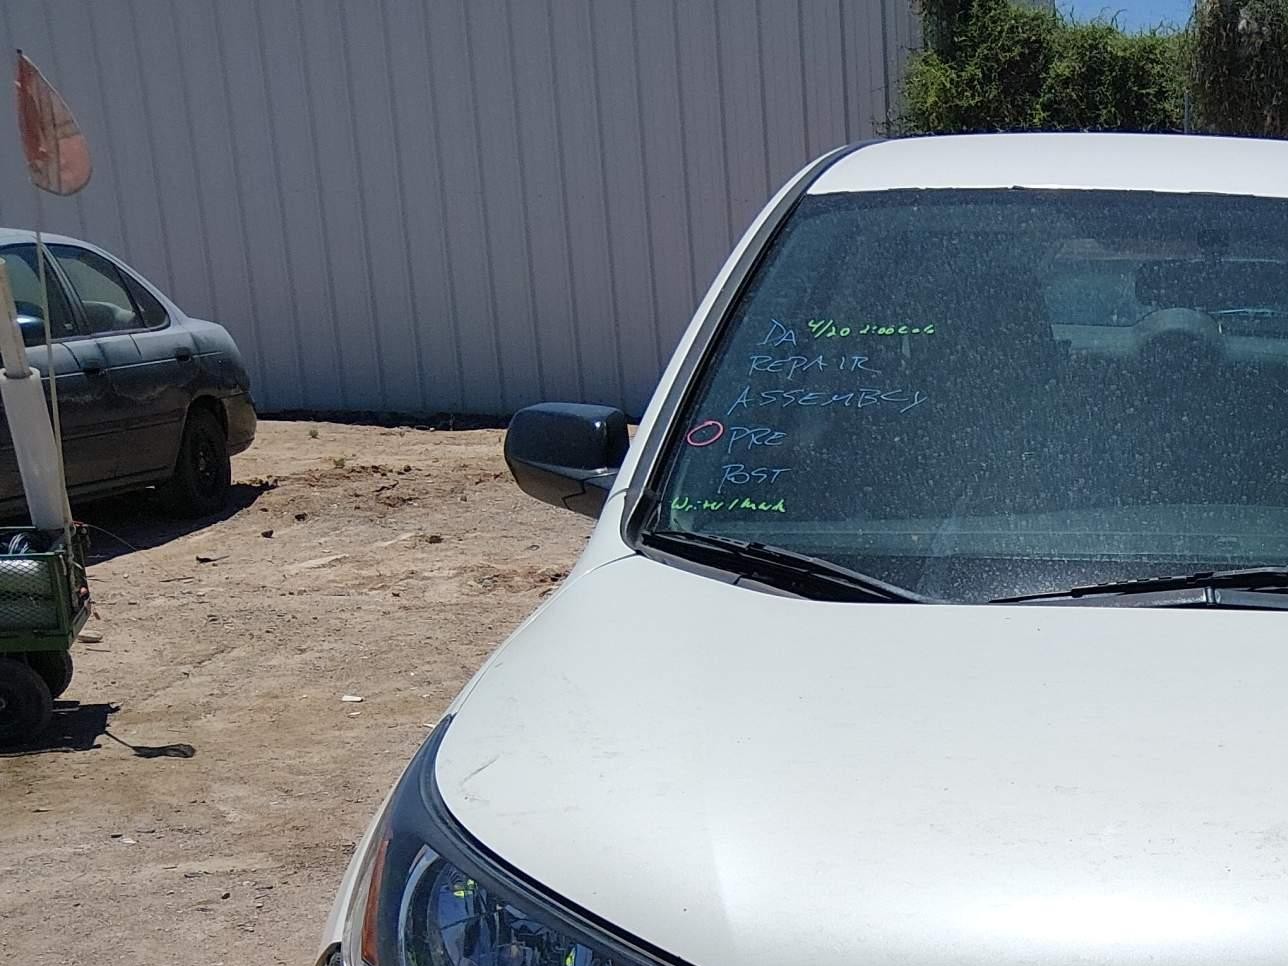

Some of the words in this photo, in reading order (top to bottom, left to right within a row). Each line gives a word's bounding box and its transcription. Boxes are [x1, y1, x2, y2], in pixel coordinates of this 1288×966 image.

[756, 319, 796, 346] DA
[749, 355, 881, 380] REPAIR
[728, 427, 787, 453] PRE
[716, 464, 792, 493] POST
